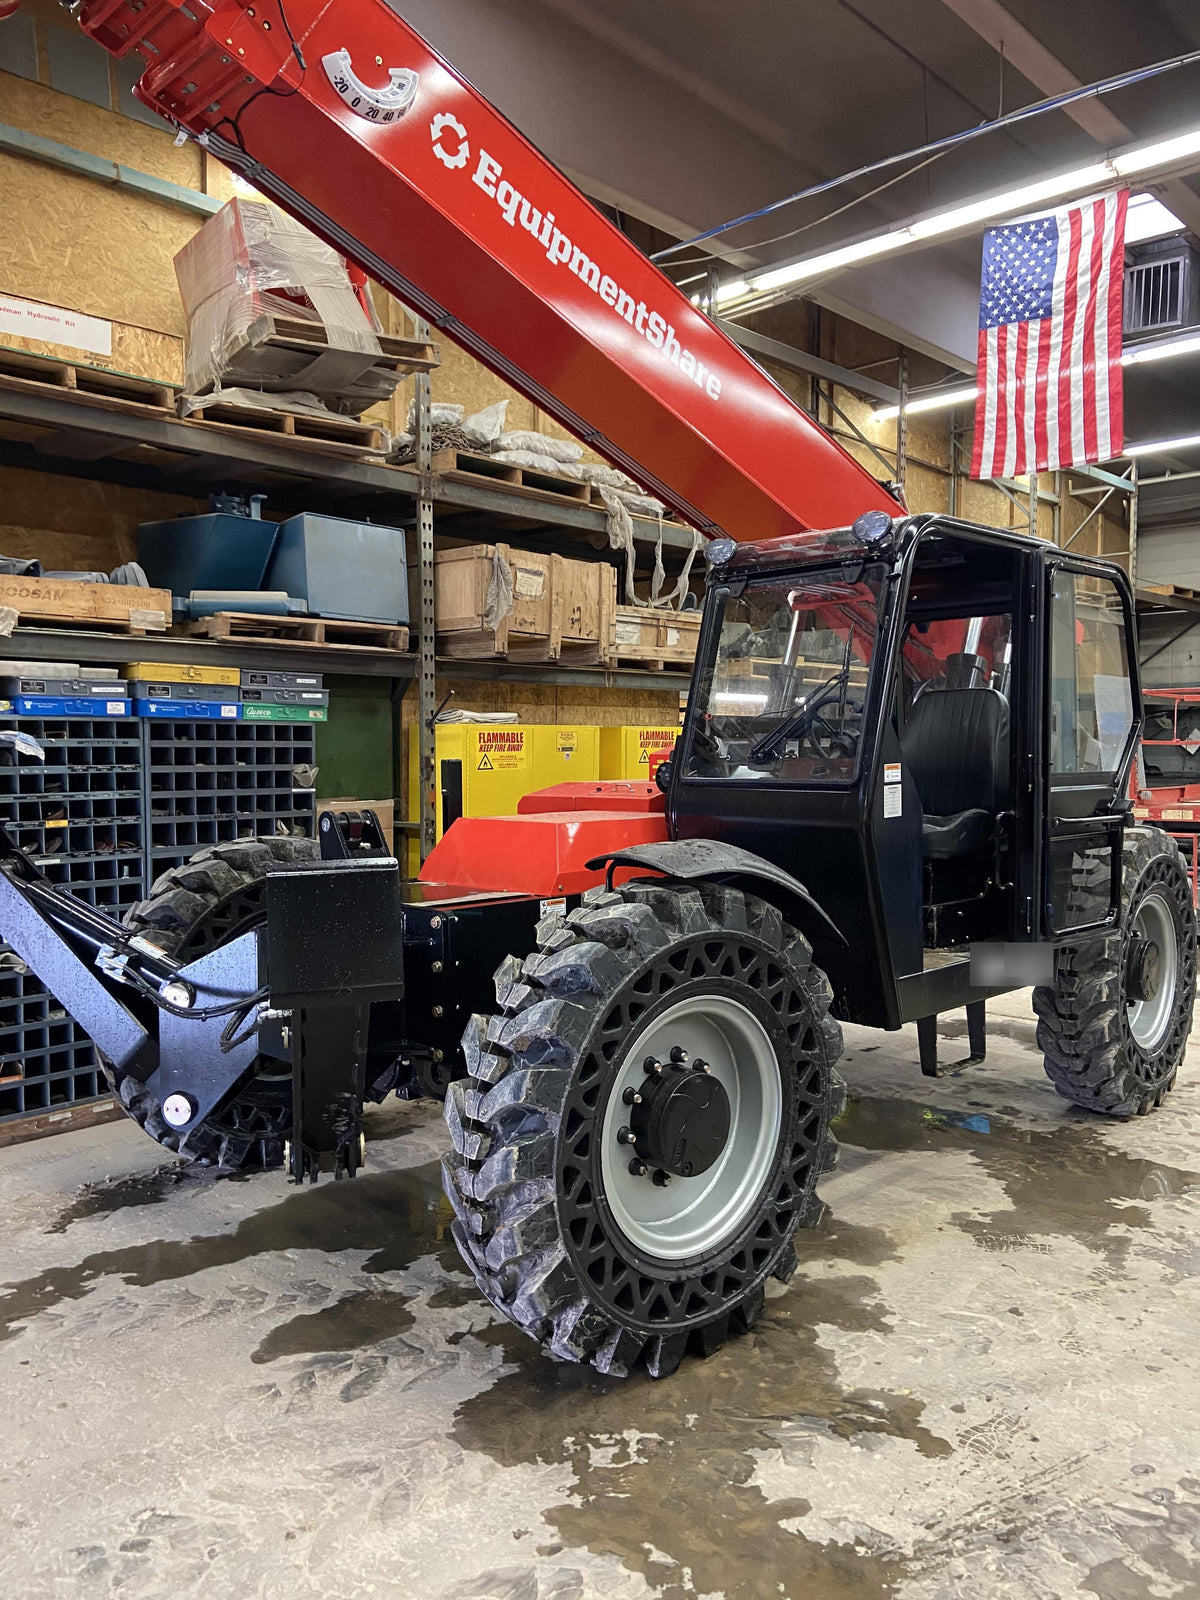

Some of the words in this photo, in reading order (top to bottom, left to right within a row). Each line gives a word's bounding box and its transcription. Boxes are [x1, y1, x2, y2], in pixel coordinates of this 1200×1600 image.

[333, 75, 349, 94] -20
[351, 97, 361, 108] 0
[365, 106, 380, 119] 20
[382, 111, 394, 121] 40
[471, 147, 722, 401] EquipmentShare
[27, 310, 61, 322] Hydraulic
[0, 585, 64, 602] OOSAN
[478, 732, 524, 744] FLAMMABLE
[639, 730, 675, 741] FLAMMABLE
[478, 743, 494, 752] KEEP
[493, 743, 506, 752] FIRE
[506, 743, 524, 752] AWAY
[639, 740, 651, 748] KEEP
[650, 740, 662, 748] FIRE
